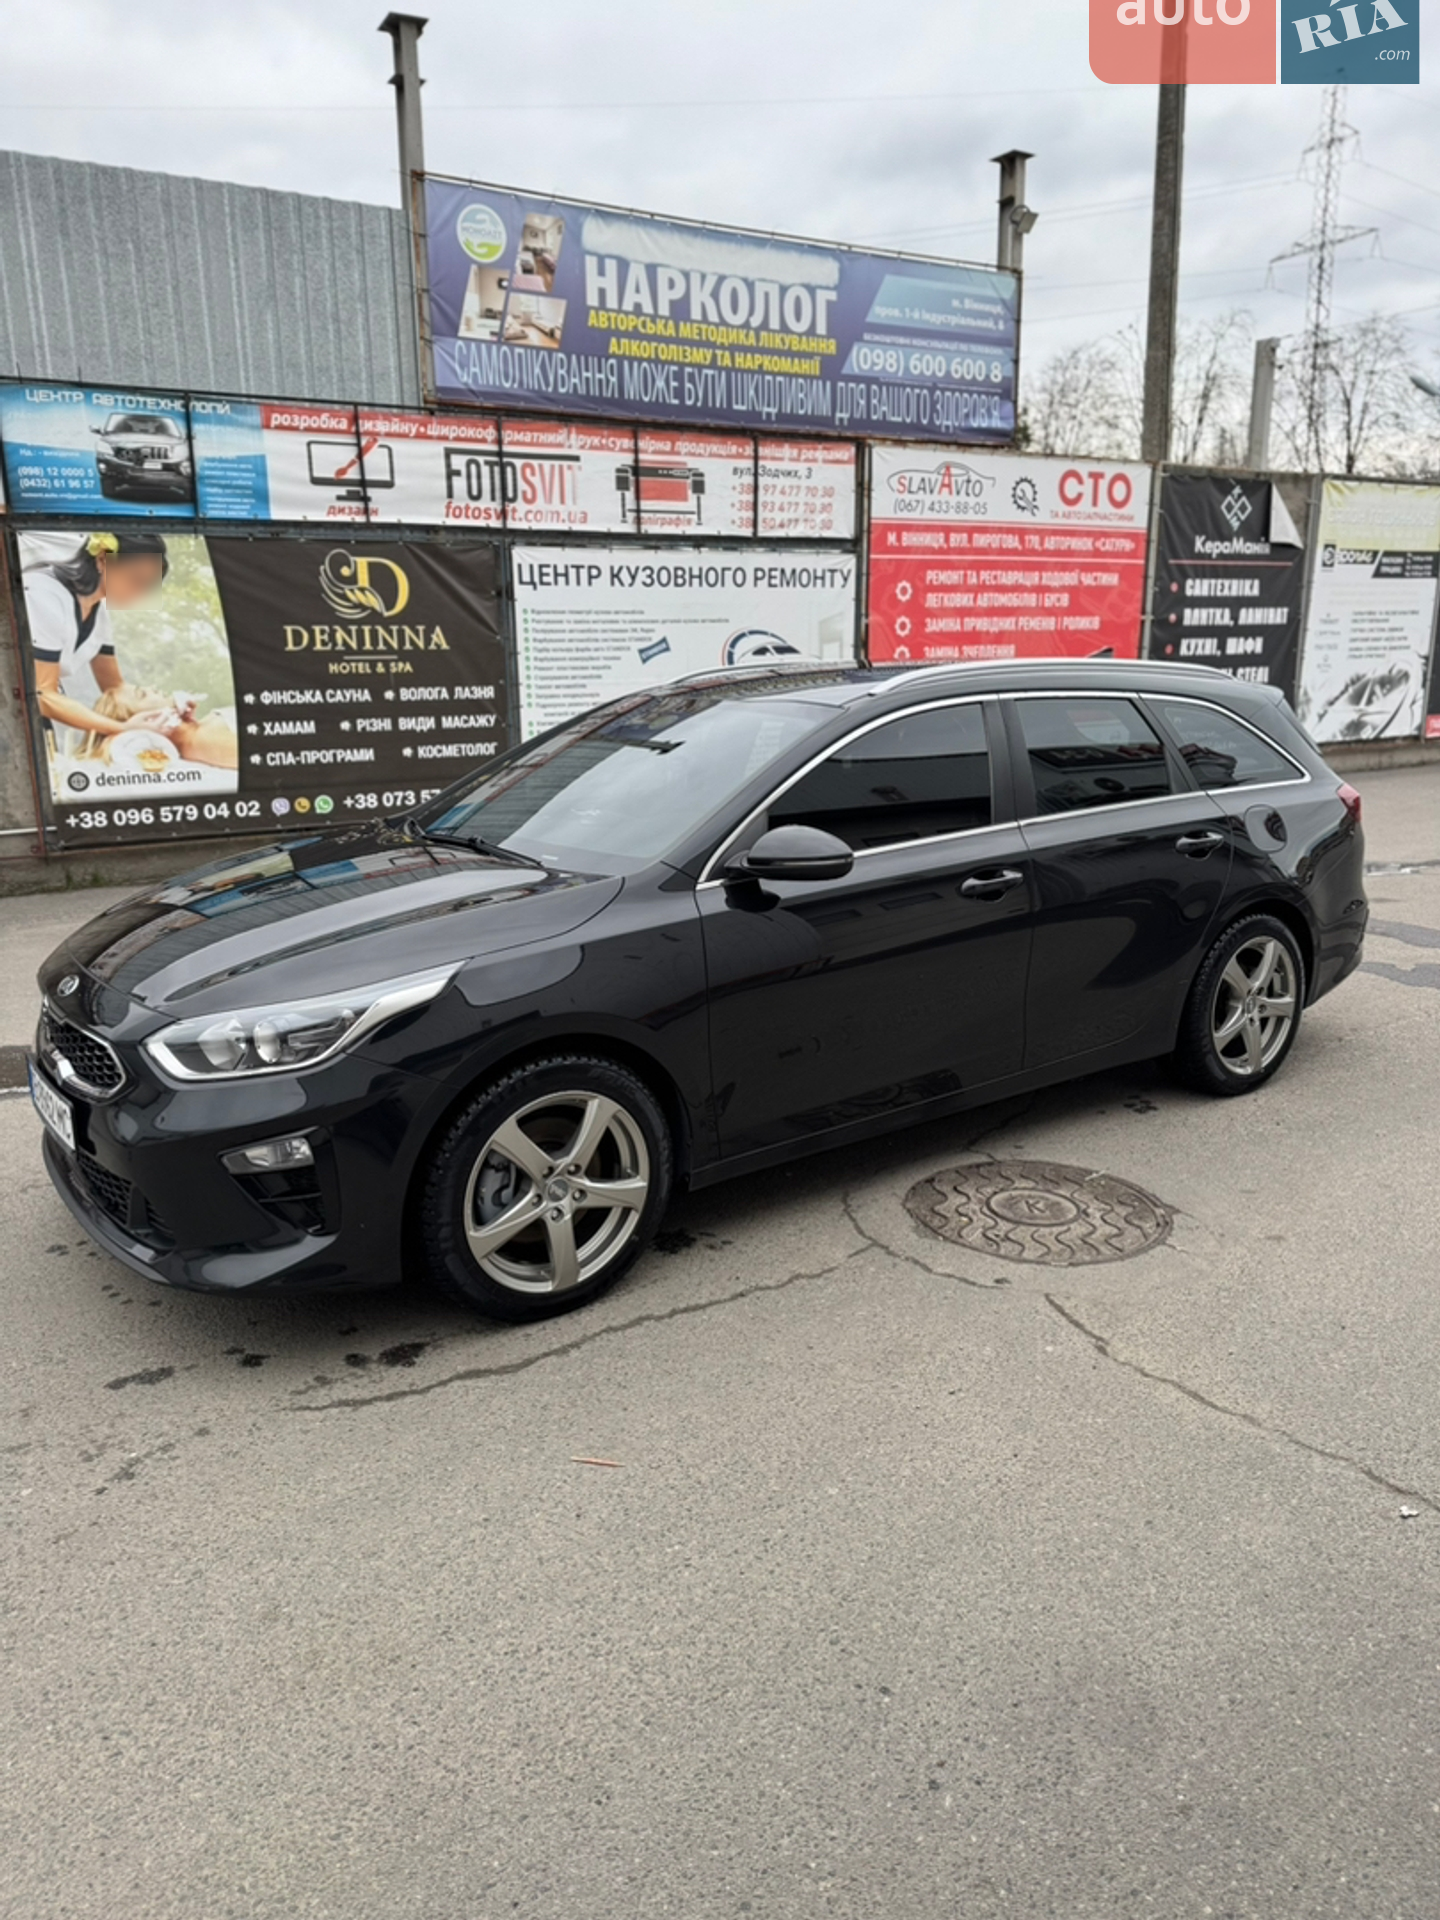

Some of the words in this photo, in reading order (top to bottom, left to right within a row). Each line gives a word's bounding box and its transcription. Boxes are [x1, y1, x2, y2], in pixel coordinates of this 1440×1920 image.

[584, 254, 838, 335] НАРКОЛОГ
[588, 309, 677, 338] АВТОРСЬКА
[679, 321, 756, 346] МЕТОДИКА
[758, 330, 837, 355] ЛІКУВАННЯ
[608, 337, 714, 366] АЛКОГОЛІЗМУ
[715, 349, 733, 368] ТА
[734, 352, 821, 376] НАРКОМАНІЇ
[852, 346, 904, 377] (098)
[909, 353, 947, 378] 600
[950, 357, 986, 382] 600
[990, 361, 1003, 383] 8
[454, 340, 619, 399] САМОЛІКУВАННЯ
[623, 359, 680, 405] МОЖЕ
[683, 367, 727, 409] БУТИ
[730, 371, 832, 422] ШКІДЛИВИМ
[835, 381, 867, 426] ДЛЯ
[870, 383, 930, 425] ВАШОГО
[25, 388, 85, 405] ЦЕНТР
[270, 412, 348, 429] розробка
[426, 421, 566, 445] широкофрматний
[674, 440, 738, 456] продукція
[18, 466, 44, 477] (098)
[46, 466, 59, 476] 12
[60, 467, 85, 477] 0000
[444, 447, 582, 505] FOTOSVIT
[732, 466, 754, 479] вул.
[758, 464, 803, 479] Зодчих,
[805, 467, 813, 479] 3
[20, 478, 52, 489] (0432)
[53, 479, 65, 488] 61
[83, 479, 95, 488] 57
[731, 483, 754, 495] +38
[1058, 469, 1133, 510] СТО
[445, 502, 588, 524] fotosvit.com.ua
[731, 500, 754, 512] +38
[893, 498, 926, 516] (067)
[927, 500, 988, 516] 433-88-05
[1050, 510, 1059, 519] ТА
[731, 517, 754, 529] +38
[887, 531, 899, 546] М.
[901, 531, 948, 549] ВІННИЦЯ,
[949, 532, 970, 547] ВУЛ.
[972, 533, 1022, 550] ПИРОГОВА,
[1045, 535, 1095, 551] АВТОРИНОК
[517, 563, 602, 591] ЦЕНТР
[610, 565, 747, 589] КУЗОВНОГО
[753, 567, 852, 589] РЕМОНТУ
[926, 570, 964, 585] РЕМОНТ
[966, 571, 978, 585] ТА
[979, 571, 1039, 587] РЕСТАВРАЦІЯ
[1041, 569, 1079, 587] ХОДОВОЇ
[1080, 572, 1119, 587] ЧАСТИНИ
[1184, 578, 1260, 597] САНТЕХНІКА
[925, 592, 975, 608] ЛЕГКОВИХ
[976, 592, 1037, 608] АВТОМОБІЛІВ
[1044, 592, 1070, 607] БУСІВ
[925, 617, 961, 633] ЗАМІНА
[963, 616, 1016, 634] ПРИВІДНИХ
[1018, 616, 1056, 631] РЕМЕНІВ
[1062, 616, 1100, 631] РОЛИКІВ
[1182, 607, 1235, 627] ПЛИТКА,
[1238, 607, 1289, 625] ЛАМІНАТ
[282, 625, 451, 651] DENINNA
[1180, 637, 1221, 657] КУХНІ,
[1225, 636, 1263, 655] ШАФИ
[923, 645, 959, 659] ЗАМІНА
[328, 662, 372, 674] HOTEL
[375, 662, 386, 674] &
[389, 661, 414, 673] SPA
[260, 690, 325, 705] ФІНСЬКА
[325, 688, 372, 704] САУНА
[399, 686, 449, 701] ВОЛОГА
[453, 686, 496, 700] ЛАЗНЯ
[263, 720, 317, 736] ХАМАМ
[356, 718, 392, 732] РІЗНІ
[398, 716, 436, 733] ВИДИ
[441, 714, 497, 729] МАСАЖУ
[266, 748, 375, 766] СПА-ПРОГРАМИ
[417, 742, 498, 759] КОСМЕТОЛОГ
[95, 769, 202, 787] deninna.com
[343, 793, 378, 809] +38
[382, 791, 416, 807] 073
[65, 811, 108, 829] +38
[112, 808, 155, 826] 096
[160, 804, 199, 823] 579
[203, 803, 230, 820] 04
[235, 801, 261, 817] 02
